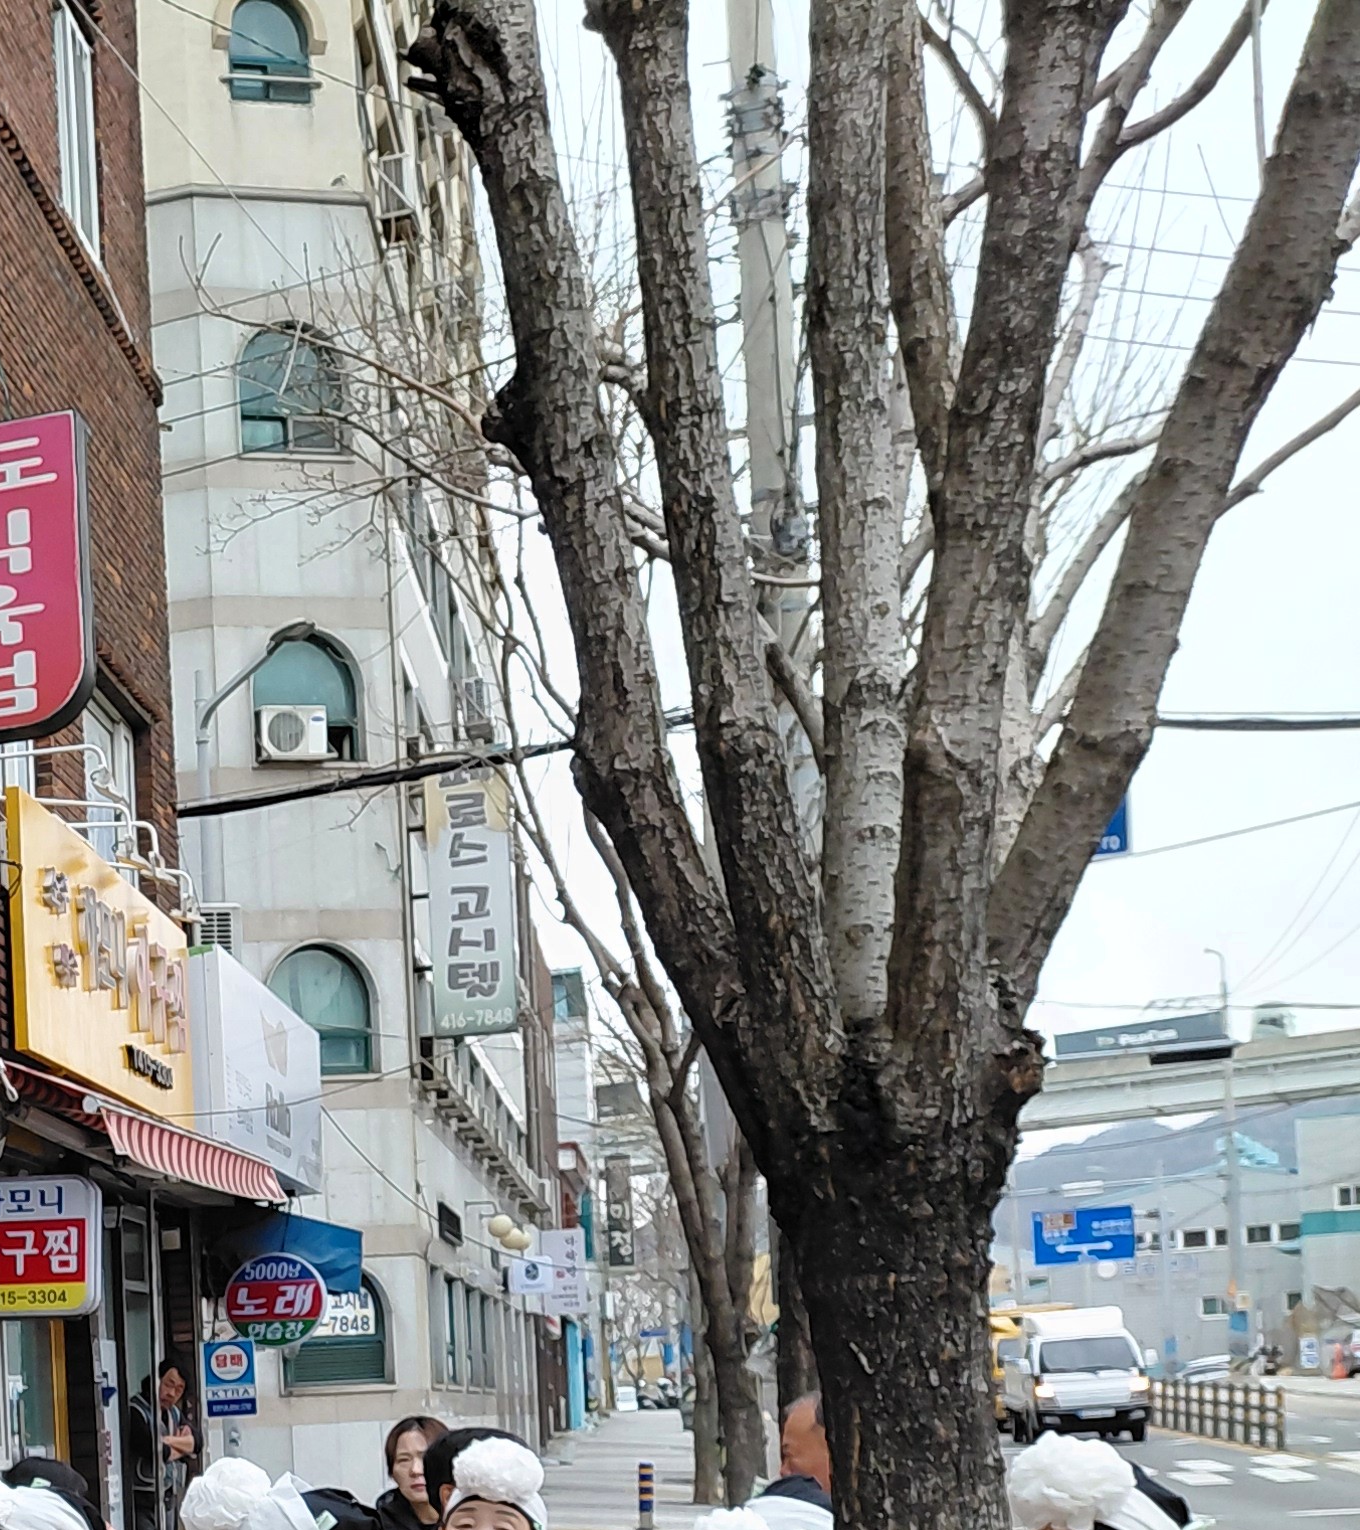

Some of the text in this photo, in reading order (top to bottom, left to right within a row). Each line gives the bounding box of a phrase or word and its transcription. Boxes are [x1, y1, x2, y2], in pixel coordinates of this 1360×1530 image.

[447, 884, 501, 999] 고시텔
[440, 1006, 514, 1031] 416-7848
[231, 1283, 316, 1317] 노래
